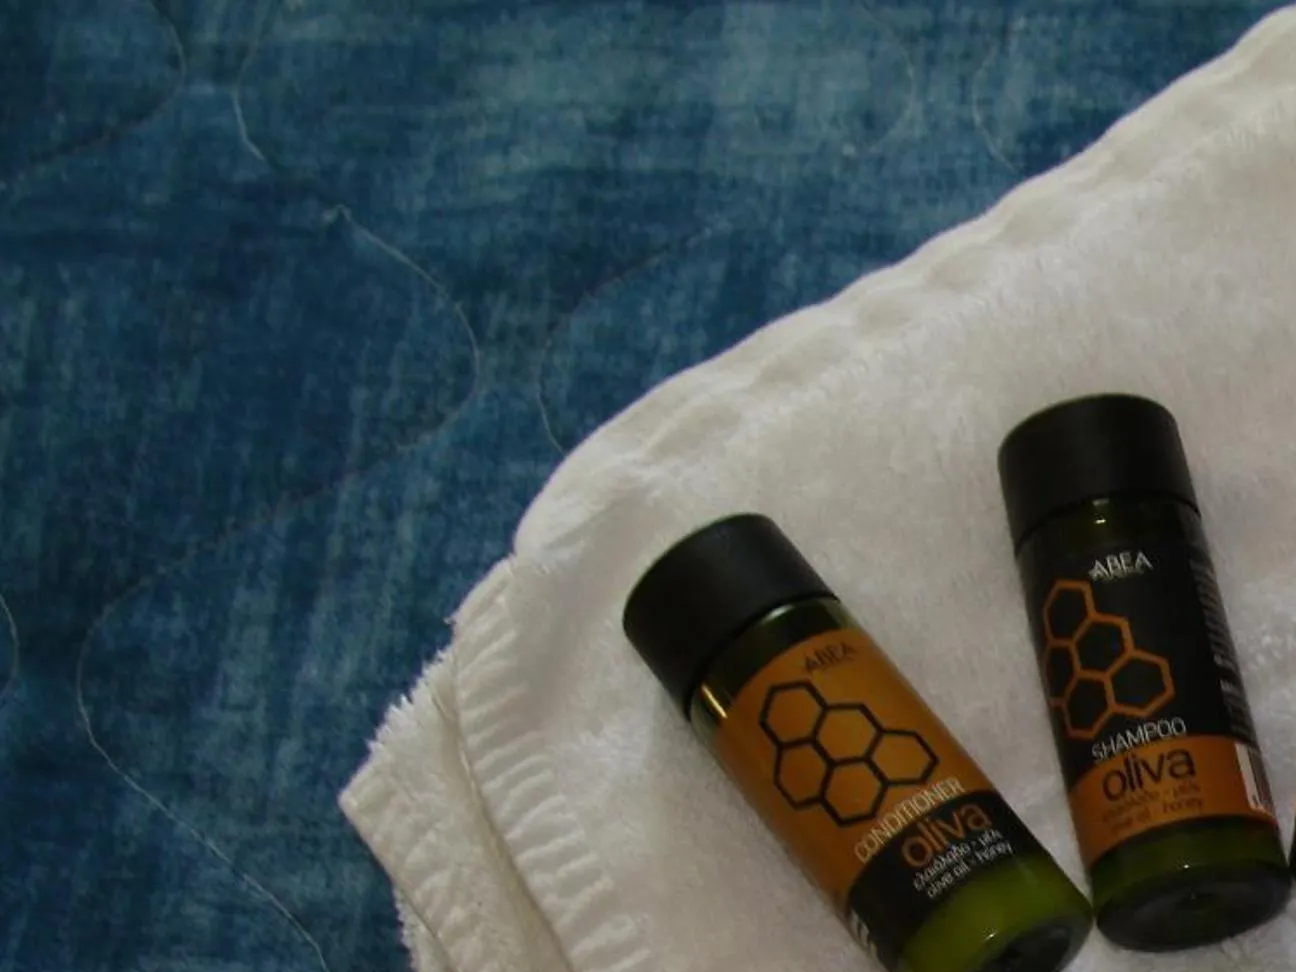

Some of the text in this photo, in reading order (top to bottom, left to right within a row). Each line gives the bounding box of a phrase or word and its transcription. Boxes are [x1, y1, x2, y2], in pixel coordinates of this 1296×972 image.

[1092, 716, 1188, 762] SHAMPOO
[1102, 748, 1197, 801] oliva
[854, 776, 966, 864] CONDITIONER
[901, 804, 993, 868] oliva
